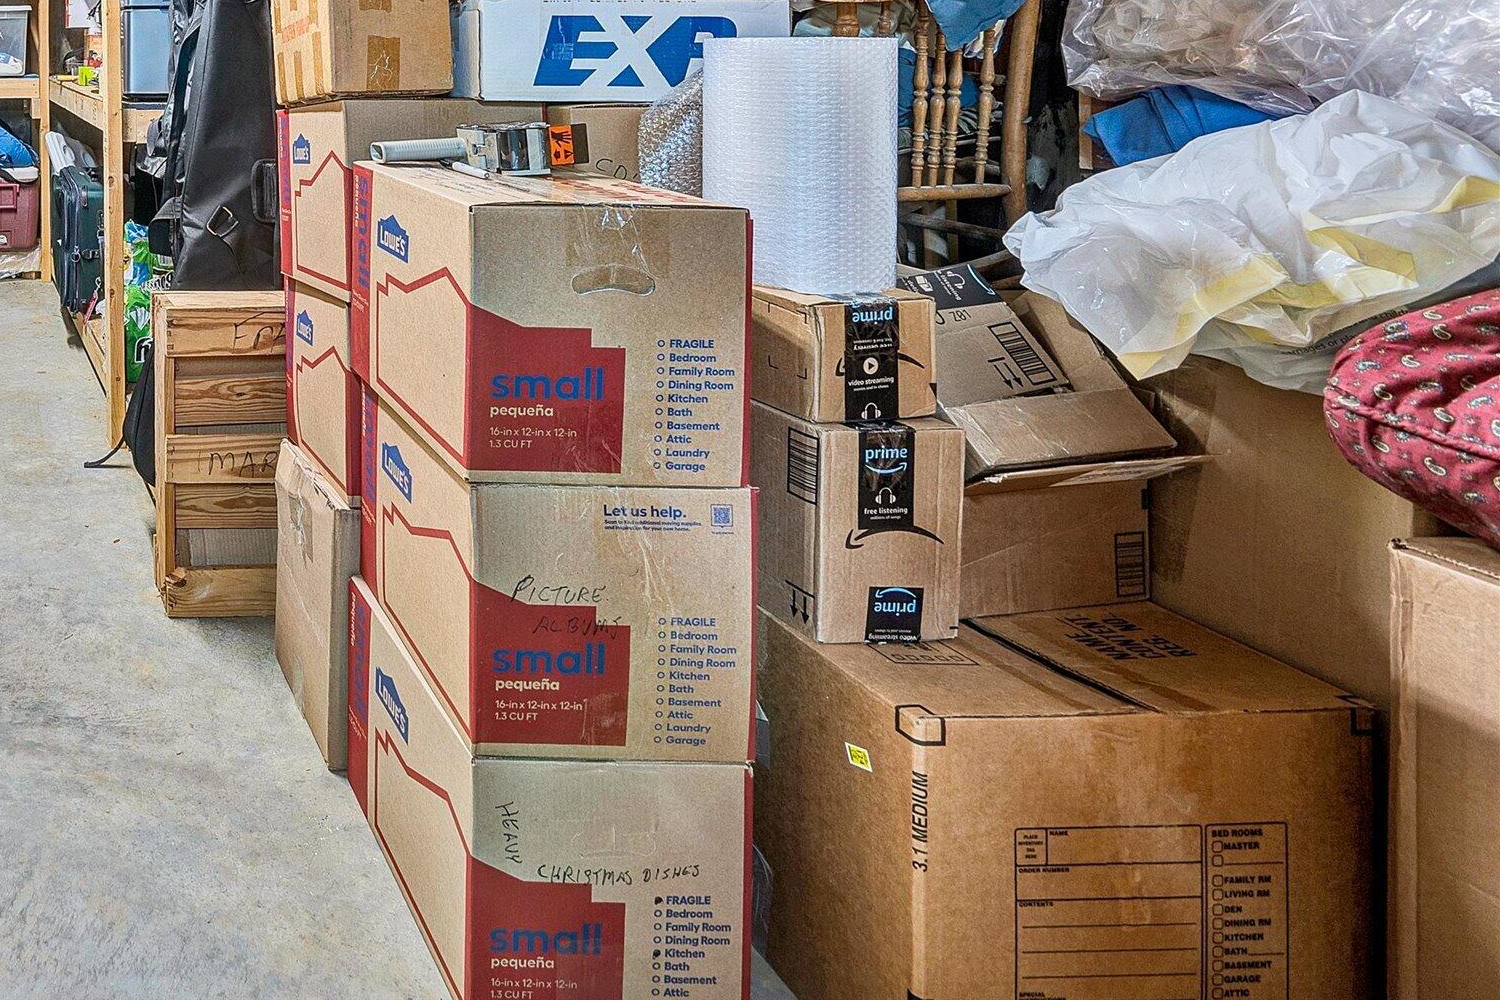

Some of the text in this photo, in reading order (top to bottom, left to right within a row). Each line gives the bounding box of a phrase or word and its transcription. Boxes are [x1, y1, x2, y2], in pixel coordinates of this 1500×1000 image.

[379, 224, 406, 257] LOWE'S
[852, 306, 893, 325] prime
[670, 340, 714, 349] FRAGILE
[669, 354, 716, 363] Bedroom
[669, 367, 735, 377] Family Room
[490, 367, 605, 400] small
[865, 376, 894, 385] streaming
[668, 381, 734, 391] Dining Room
[668, 394, 708, 403] Kitchen
[490, 405, 554, 419] pequeña
[667, 408, 692, 416] Bath
[666, 421, 720, 431] Basement
[490, 427, 512, 437] 16-in
[514, 429, 520, 437] x
[521, 427, 544, 437] 12-in
[554, 428, 577, 438] 12-in
[489, 440, 532, 448] 1.3 CU FT
[666, 435, 692, 444] Attic
[666, 448, 710, 458] Laundry
[865, 445, 908, 463] prime
[665, 462, 706, 472] Garage
[384, 457, 411, 496] LOWE'S
[603, 504, 687, 521] Let us help.
[873, 599, 917, 617] prime
[670, 618, 716, 627] FRAGILE
[670, 631, 718, 641] Bedroom
[670, 645, 737, 655] Family Room
[491, 642, 606, 675] small
[669, 658, 736, 669] Dining Room
[669, 672, 711, 681] Kitchen
[495, 678, 560, 693] pequeña
[669, 685, 694, 694] Bath
[377, 675, 408, 735] LOWE'S
[495, 700, 518, 710] 16-in
[527, 700, 550, 710] 12-in
[559, 701, 583, 711] 12-in
[668, 698, 721, 708] Basement
[494, 712, 538, 721] 1.3 CU FT
[667, 710, 693, 720] Attic
[666, 723, 711, 733] Laundry
[665, 736, 707, 746] Garage
[911, 771, 929, 873] 3.1 MEDIUM
[495, 801, 523, 864] HEAVY
[1231, 829, 1263, 837] ROOMS
[1224, 842, 1260, 850] MASTER
[537, 864, 700, 886] CHRISTMAS DISHES
[1224, 875, 1272, 884] FAMILY RM
[1224, 890, 1254, 898] LIVING
[666, 896, 711, 905] FRAGILE
[666, 909, 713, 918] Bedroom
[665, 922, 732, 933] Family Room
[1224, 919, 1256, 927] DINING
[489, 924, 603, 954] small
[665, 936, 730, 946] Dining Room
[1224, 933, 1264, 941] KITCHEN
[665, 949, 705, 958] Kitchen
[1224, 948, 1247, 956] BATH
[490, 957, 555, 970] pequeña
[664, 962, 690, 971] Bath
[1224, 961, 1272, 969] BASEMENT
[490, 978, 514, 988] 16-in
[522, 978, 545, 988] 12-in
[554, 979, 578, 989] 12-in
[663, 975, 717, 985] Basement
[1224, 975, 1261, 984] GARAGE
[490, 990, 534, 999] 1.3 CU FT
[663, 988, 689, 998] Attic
[1223, 989, 1250, 997] ATTIC
